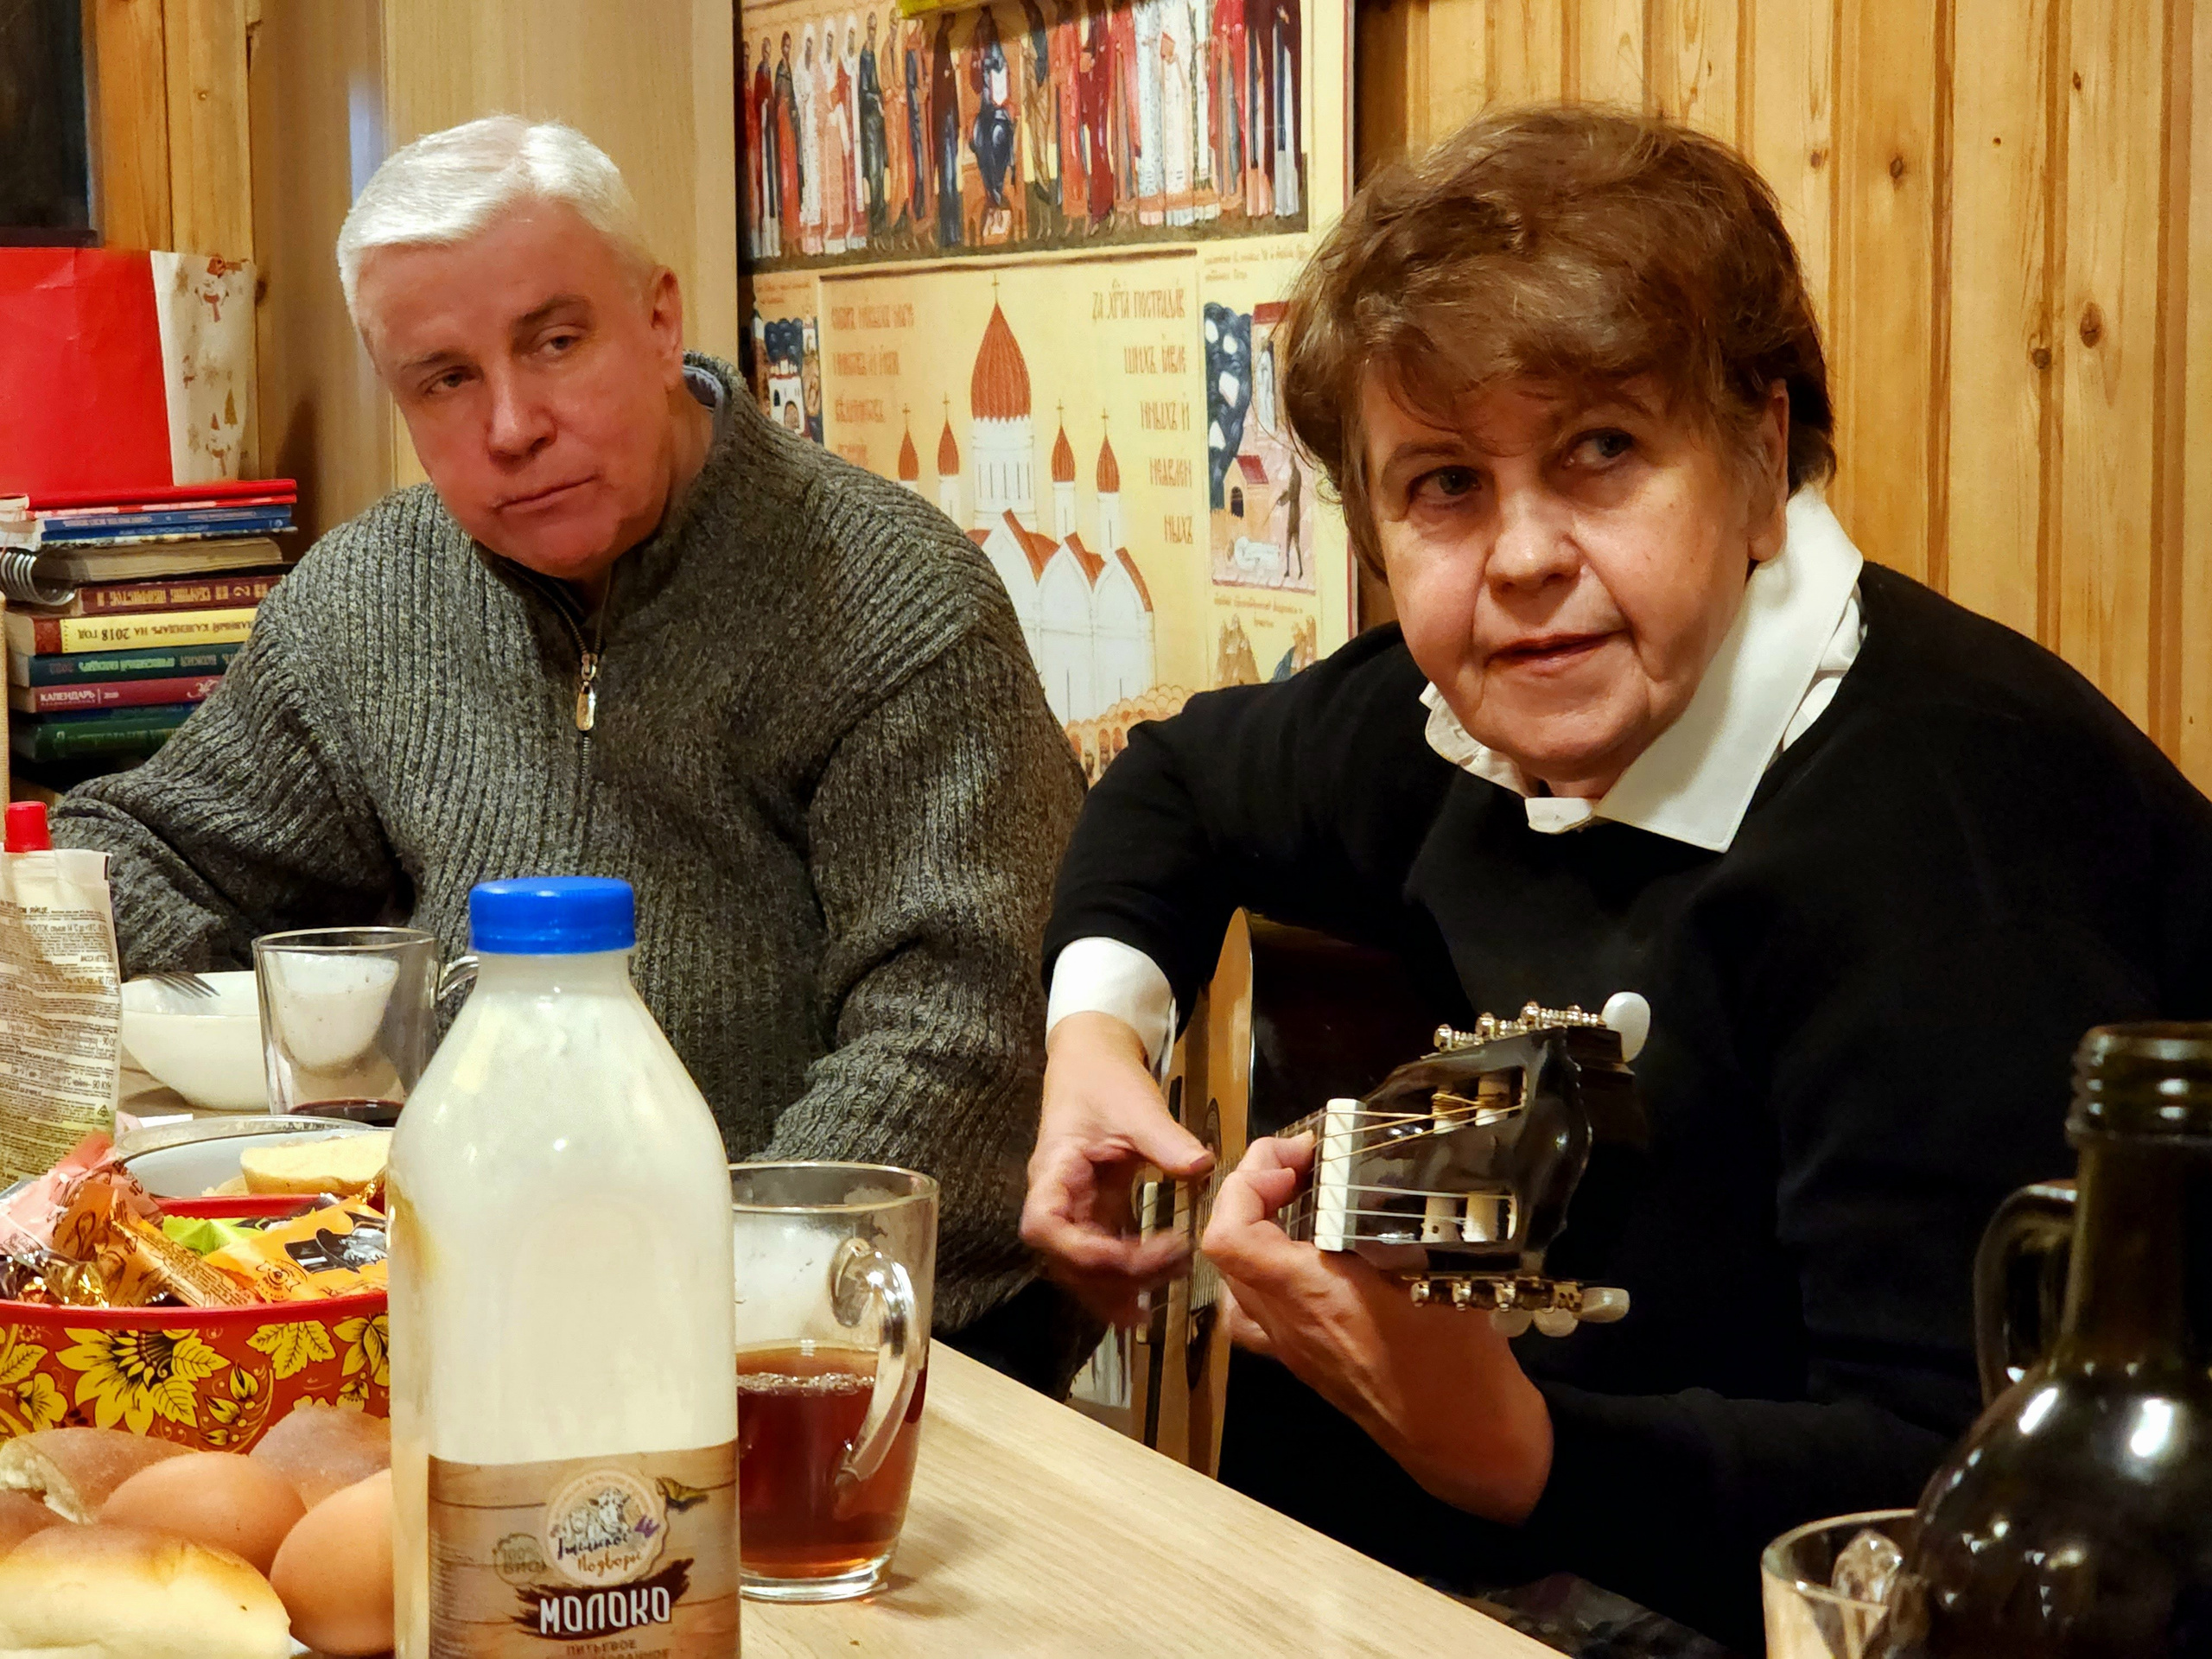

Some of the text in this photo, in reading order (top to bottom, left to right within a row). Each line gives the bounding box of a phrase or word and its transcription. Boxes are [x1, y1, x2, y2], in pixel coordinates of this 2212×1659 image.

[78, 628, 98, 639] ГОД
[101, 628, 130, 641] 2018
[134, 626, 149, 636] НА
[40, 690, 96, 702] КАЛЕНДАРЬ
[539, 1586, 671, 1636] МОЛОКО
[566, 1639, 638, 1656] ПИТЬЕВОЕ
